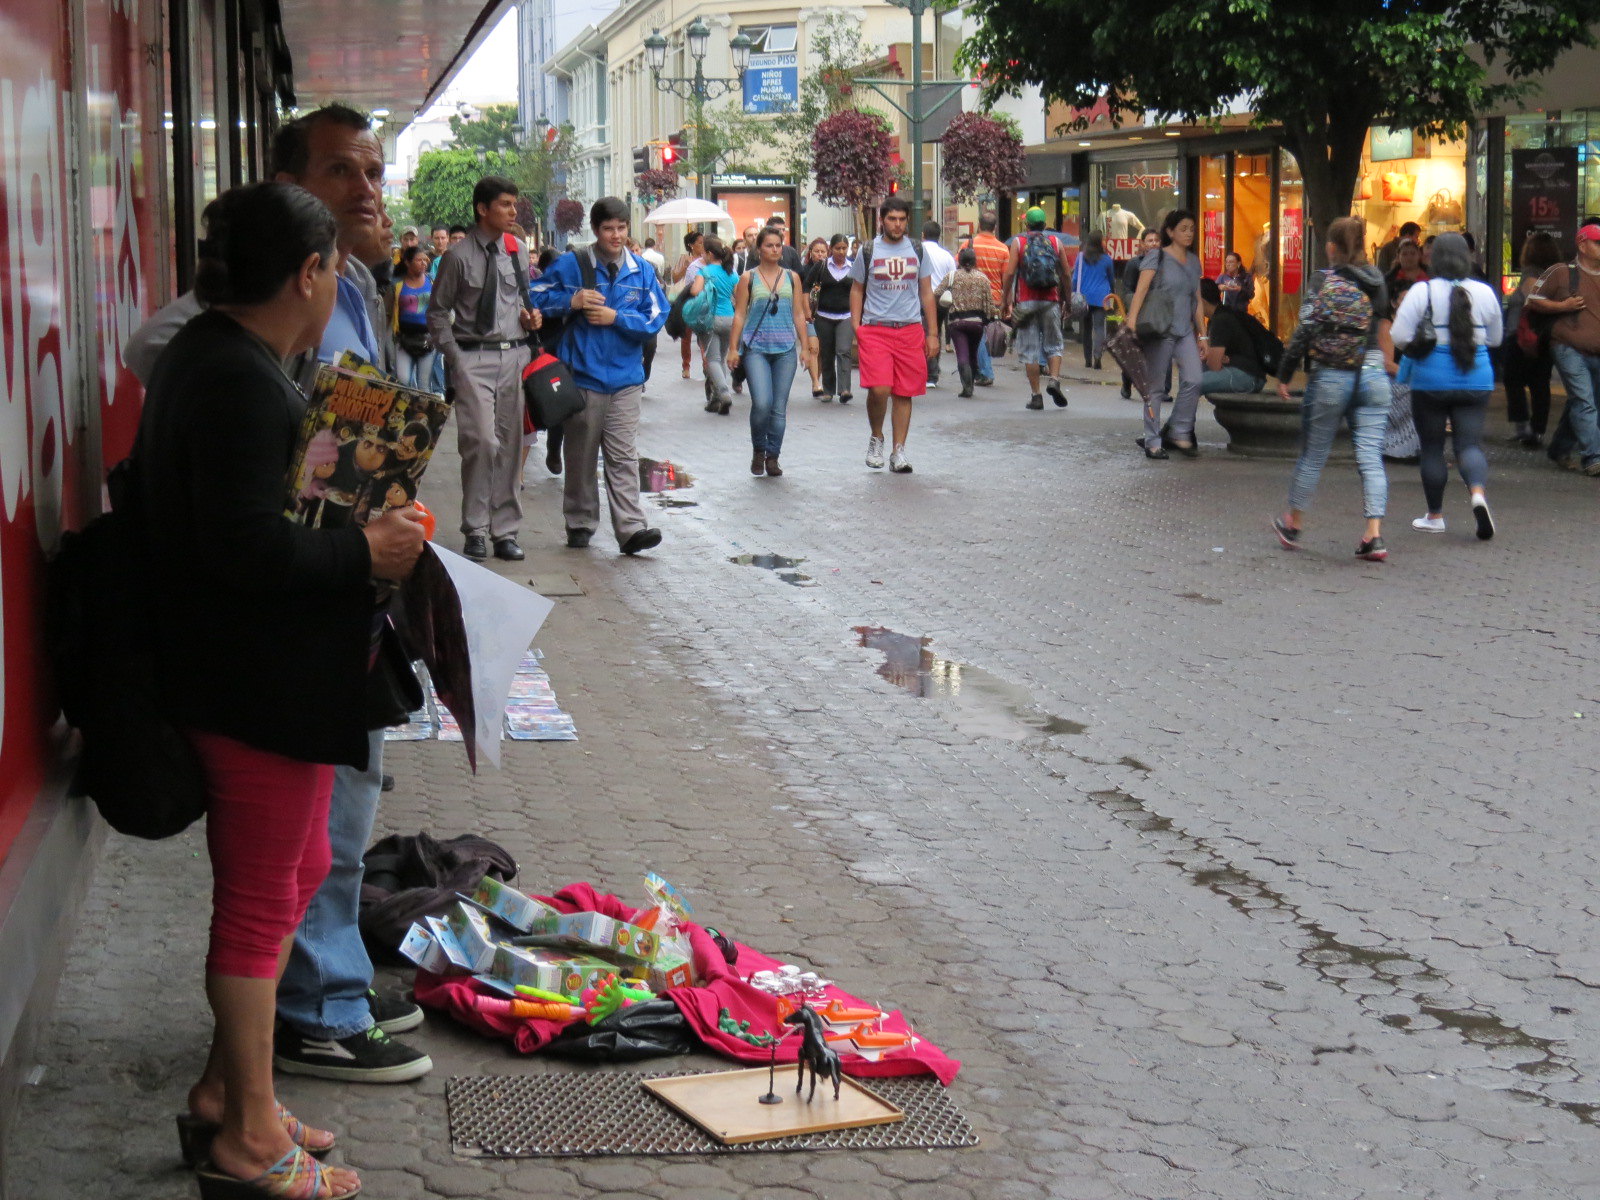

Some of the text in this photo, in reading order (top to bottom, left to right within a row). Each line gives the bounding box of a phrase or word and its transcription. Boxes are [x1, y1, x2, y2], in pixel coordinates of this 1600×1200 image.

[777, 54, 796, 65] PISO
[761, 69, 782, 79] NIÑOS
[1106, 239, 1140, 260] SALE
